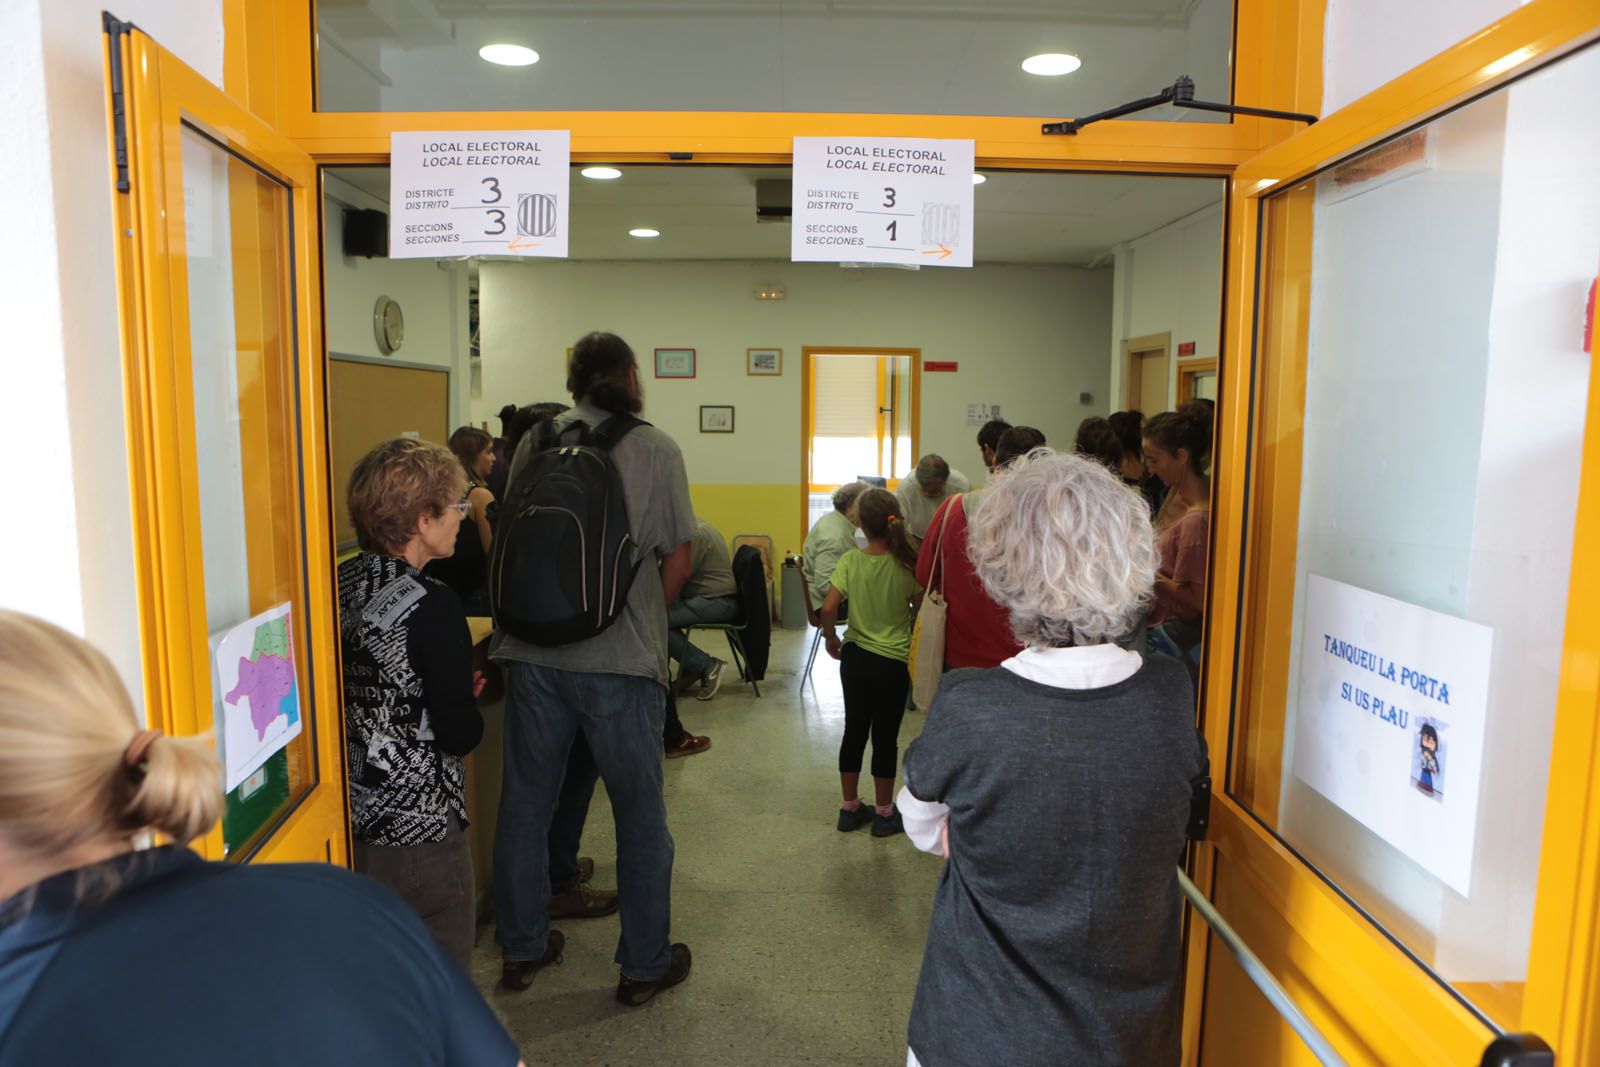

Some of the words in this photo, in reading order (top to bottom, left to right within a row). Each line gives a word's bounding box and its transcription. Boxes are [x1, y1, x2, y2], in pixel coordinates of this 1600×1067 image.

[423, 143, 463, 152] LOCAL
[467, 142, 541, 151] ELECTORAL
[827, 146, 868, 156] LOCAL
[873, 148, 946, 161] ELECTORAL
[422, 157, 462, 167] LOCAL
[467, 156, 541, 166] ELECTORAL
[827, 160, 868, 170] LOCAL
[872, 162, 945, 175] ELECTORAL
[405, 189, 454, 198] DISTRICTE
[481, 177, 502, 203] 3
[808, 189, 859, 199] DISTRICTE
[883, 188, 896, 208] 3
[405, 200, 449, 210] DISTRITO
[807, 201, 853, 210] DISTRITO
[405, 223, 453, 233] SECCIONS
[484, 210, 506, 235] 3
[806, 225, 858, 233] SECCIONS
[886, 220, 897, 241] 1
[405, 234, 460, 244] SECCIONES
[806, 237, 864, 245] SECCIONES
[397, 584, 416, 598] THE
[378, 596, 398, 617] PLAY
[1324, 634, 1377, 672] TANQUEU
[1379, 658, 1396, 682] LA
[1401, 666, 1449, 705] PORTA
[1341, 682, 1352, 701] SI
[1355, 688, 1369, 710] US
[1373, 697, 1408, 729] PLAU
